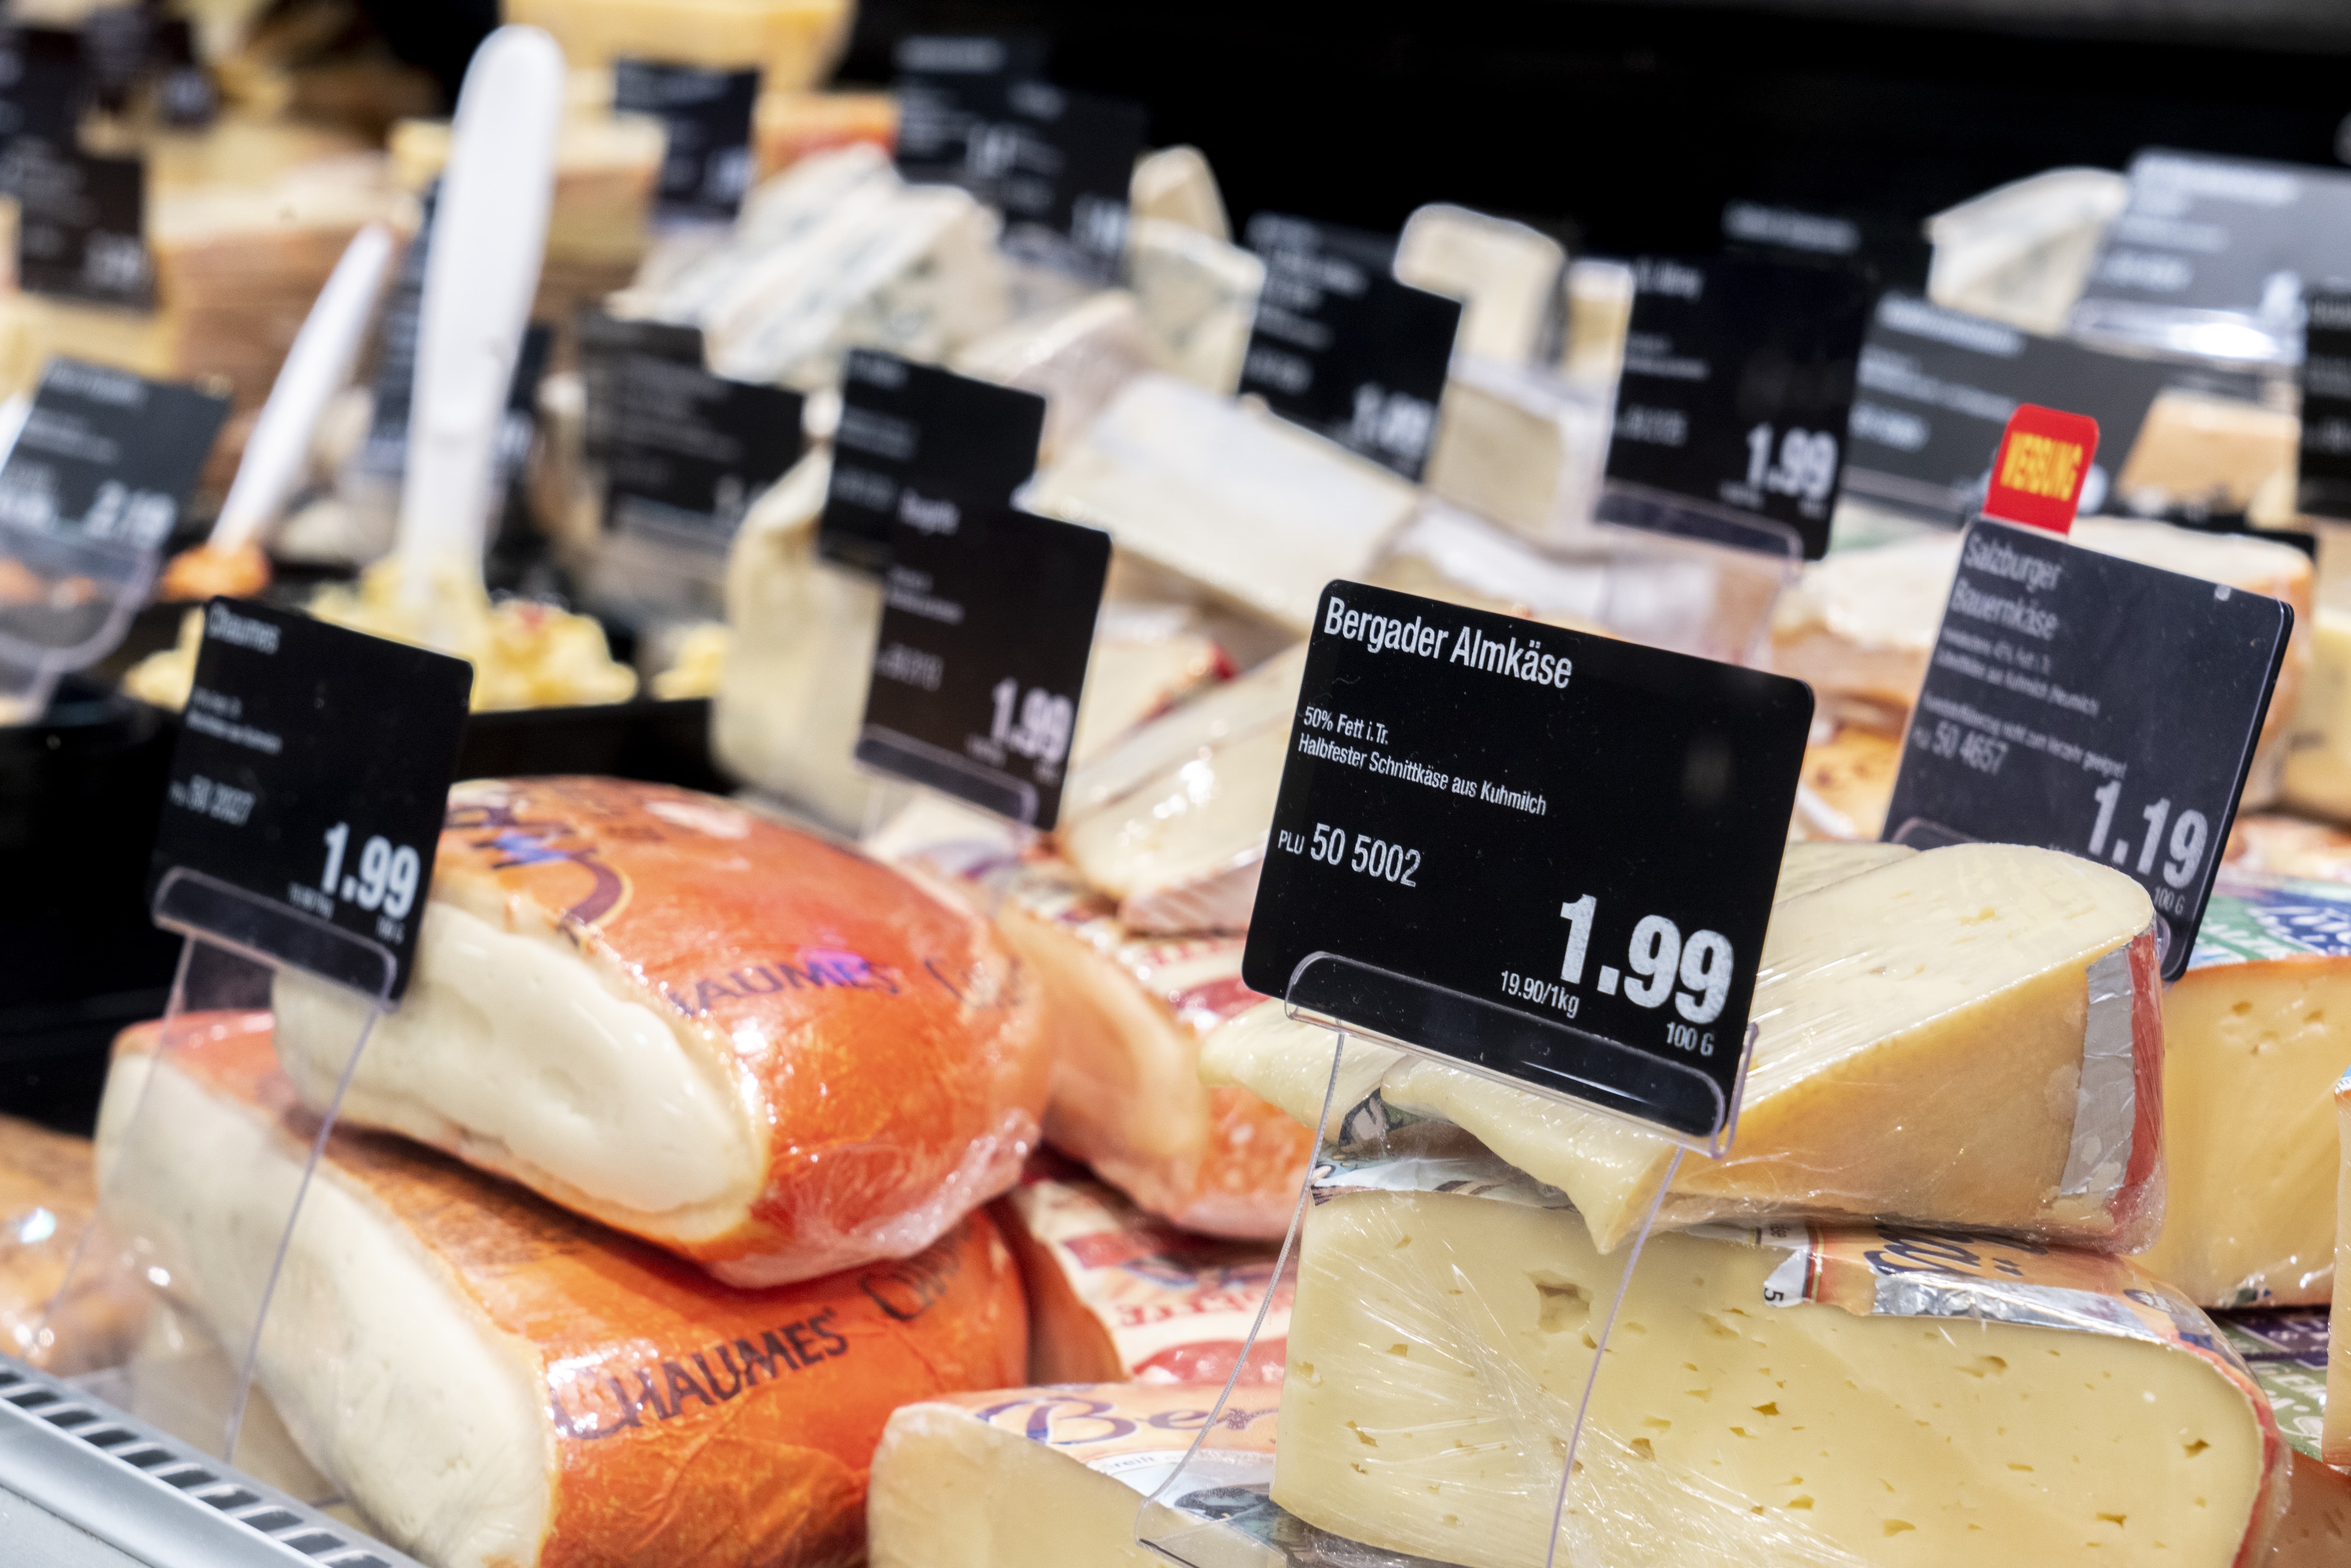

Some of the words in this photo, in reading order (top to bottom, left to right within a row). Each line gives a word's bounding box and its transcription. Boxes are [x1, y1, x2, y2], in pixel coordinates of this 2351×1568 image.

[2000, 431, 2082, 502] WERBUNG
[1964, 533, 2062, 592] Salzburger
[1324, 596, 1449, 659] Bergader
[1450, 626, 1572, 689] Almkäse
[989, 675, 1075, 764] 1.99
[1304, 706, 1333, 731] 50%
[1337, 713, 1364, 740] Fett
[1933, 720, 1960, 758] 50
[1298, 732, 1367, 769] Halbfester
[1369, 751, 1448, 790] Schnittkäse
[1452, 777, 1477, 797] aus
[1480, 780, 1546, 816] Kuhmilch
[1278, 829, 1305, 855] PLU
[1310, 823, 1345, 865] 50
[1351, 834, 1420, 887] 5002
[2088, 780, 2208, 888] 1.19
[320, 821, 420, 920] 1.99
[2154, 886, 2175, 911] 100
[2175, 895, 2185, 916] G
[1501, 970, 1580, 1019] 19.90/1kg
[1560, 894, 1734, 1024] 1.99
[1666, 1022, 1697, 1051] 100
[1700, 1033, 1714, 1056] G
[549, 1307, 849, 1441] CHAUMES
